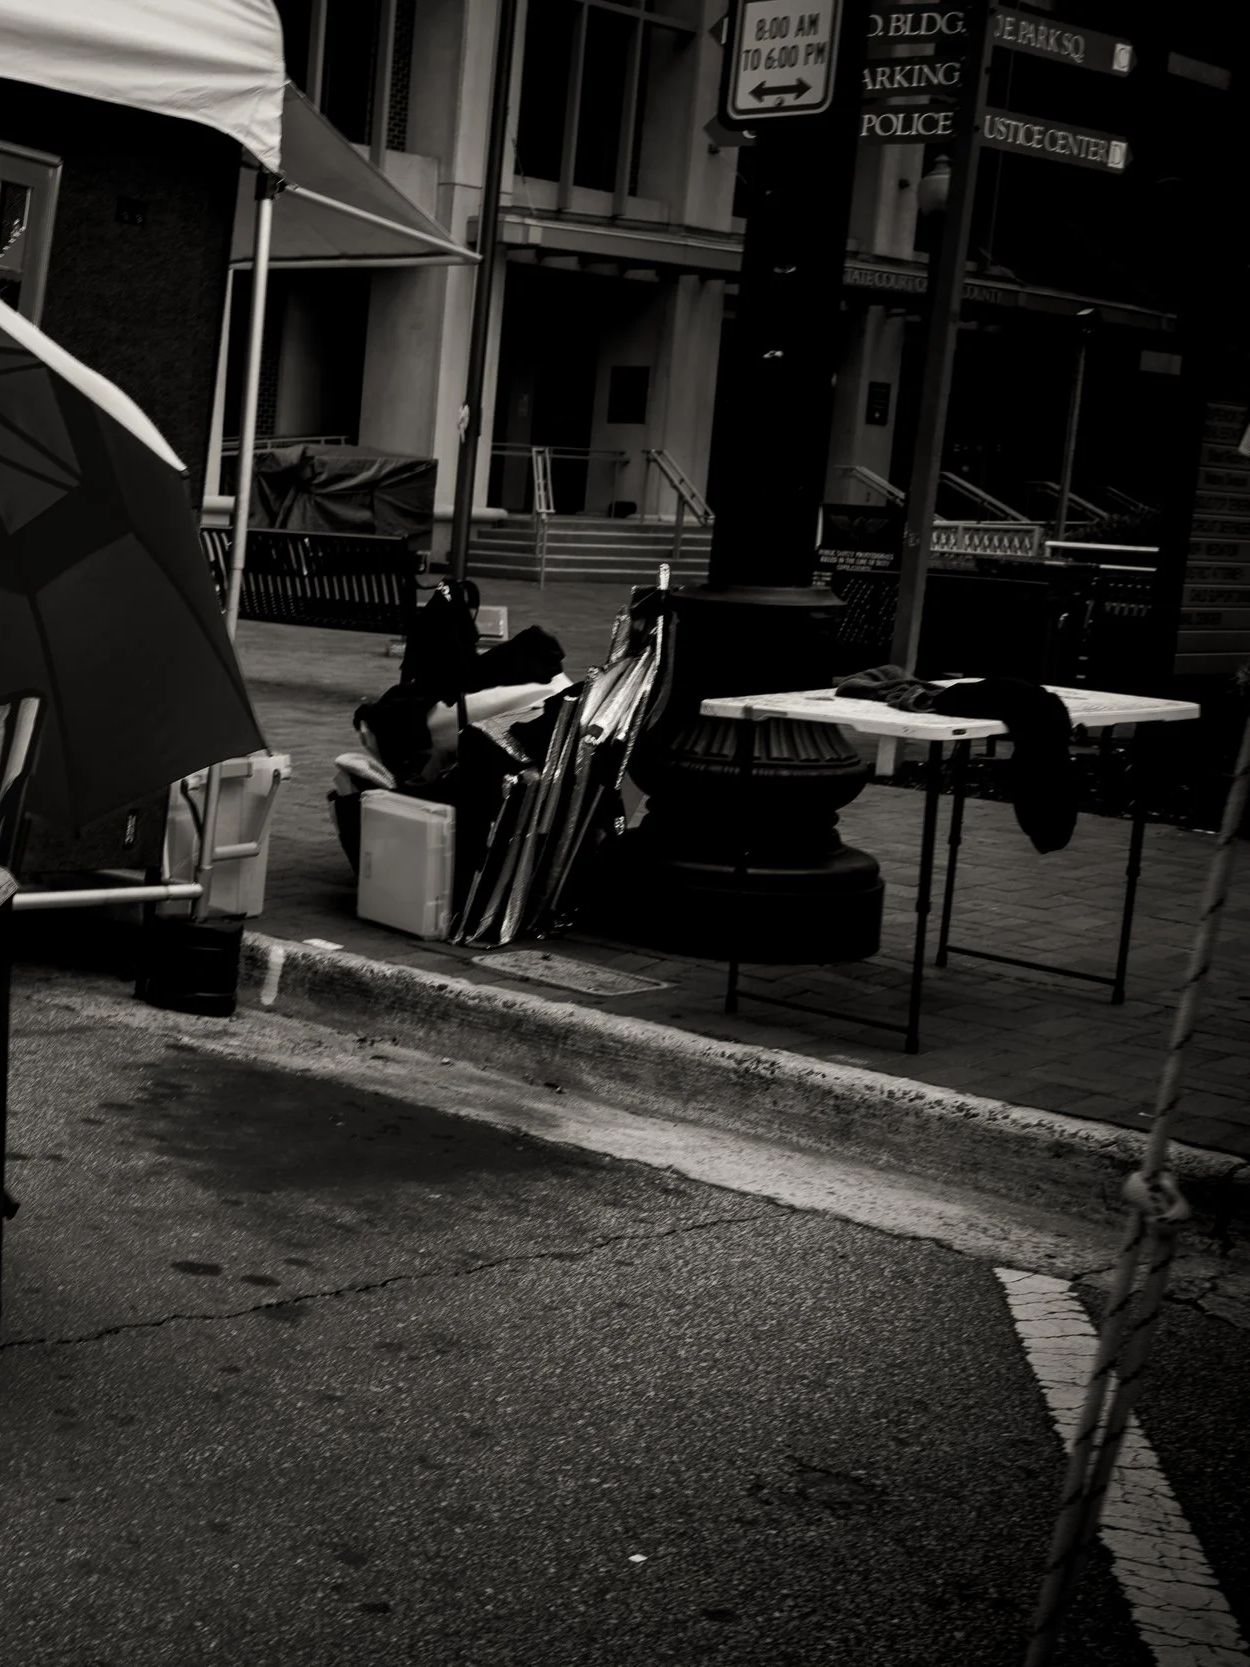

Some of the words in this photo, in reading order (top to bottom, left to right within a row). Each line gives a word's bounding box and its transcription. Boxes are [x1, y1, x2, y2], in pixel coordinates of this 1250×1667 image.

[755, 15, 790, 41] 8:00
[794, 12, 820, 37] AM
[1015, 20, 1062, 52] PARK
[743, 47, 762, 71] TO
[764, 45, 799, 70] 6:00
[803, 41, 829, 66] PM
[860, 111, 955, 136] POLICE
[1044, 129, 1109, 163] CENTER
